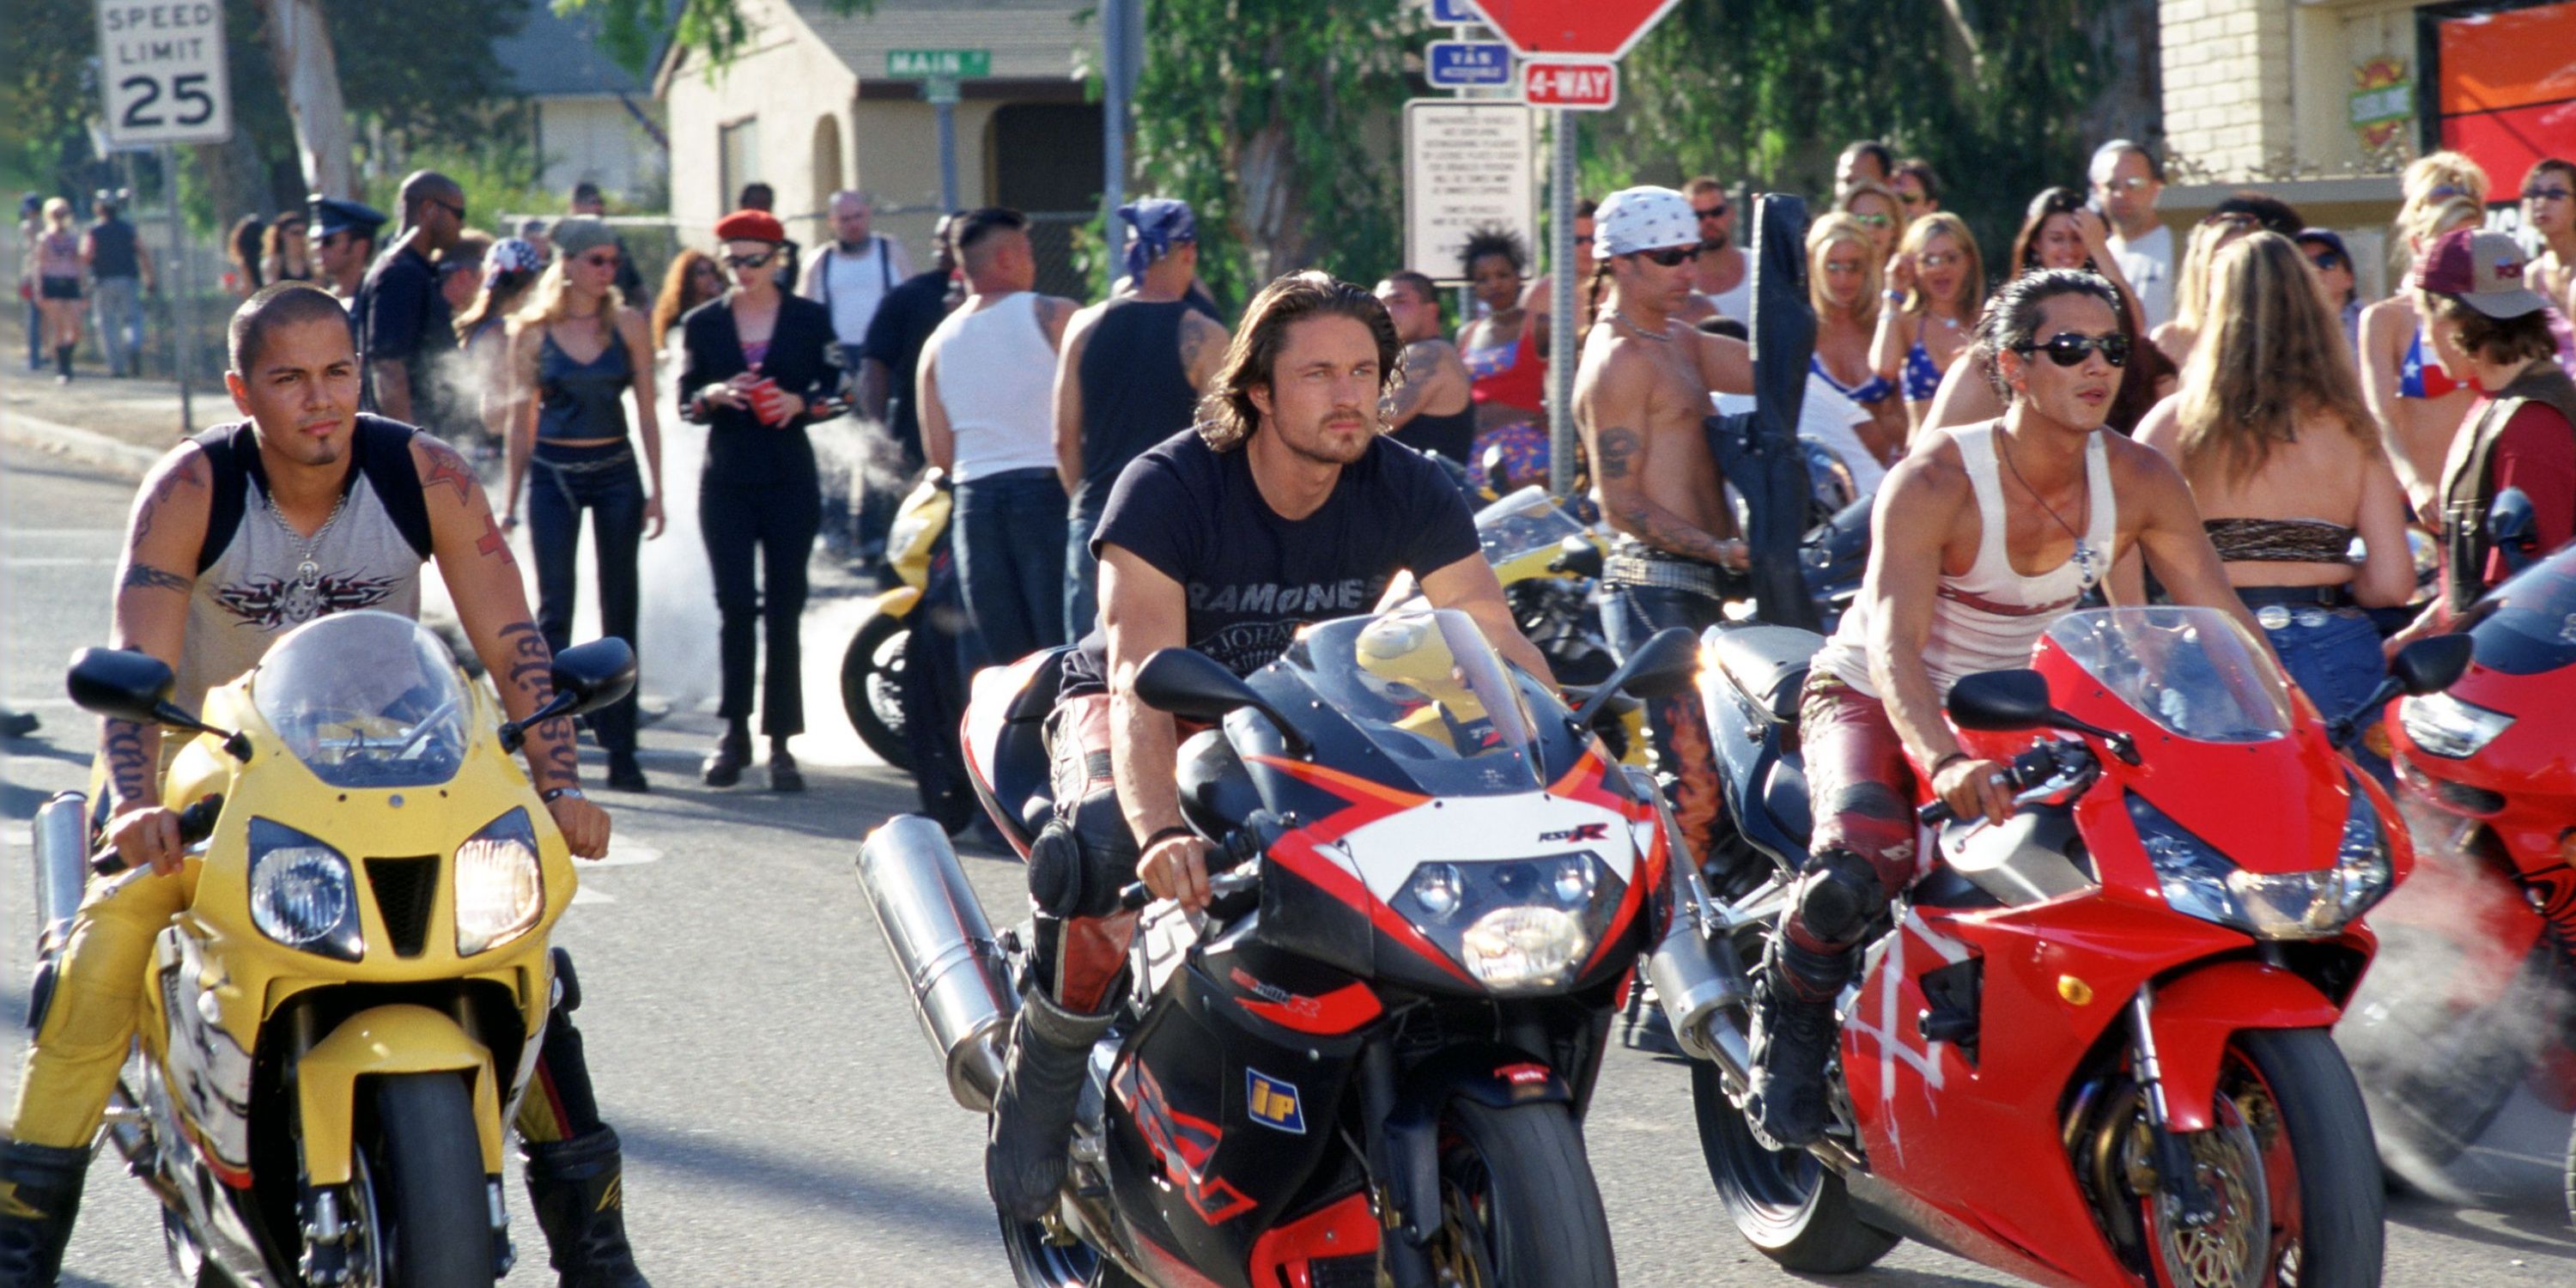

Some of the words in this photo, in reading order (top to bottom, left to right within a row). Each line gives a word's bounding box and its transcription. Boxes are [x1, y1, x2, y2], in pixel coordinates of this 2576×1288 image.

[107, 3, 212, 31] SPEED
[119, 38, 203, 64] LIMIT
[892, 53, 959, 72] MAIN
[1449, 52, 1492, 65] VAN
[1528, 70, 1609, 98] 4-WAY
[121, 74, 214, 128] 25
[1187, 574, 1387, 615] RAMONES
